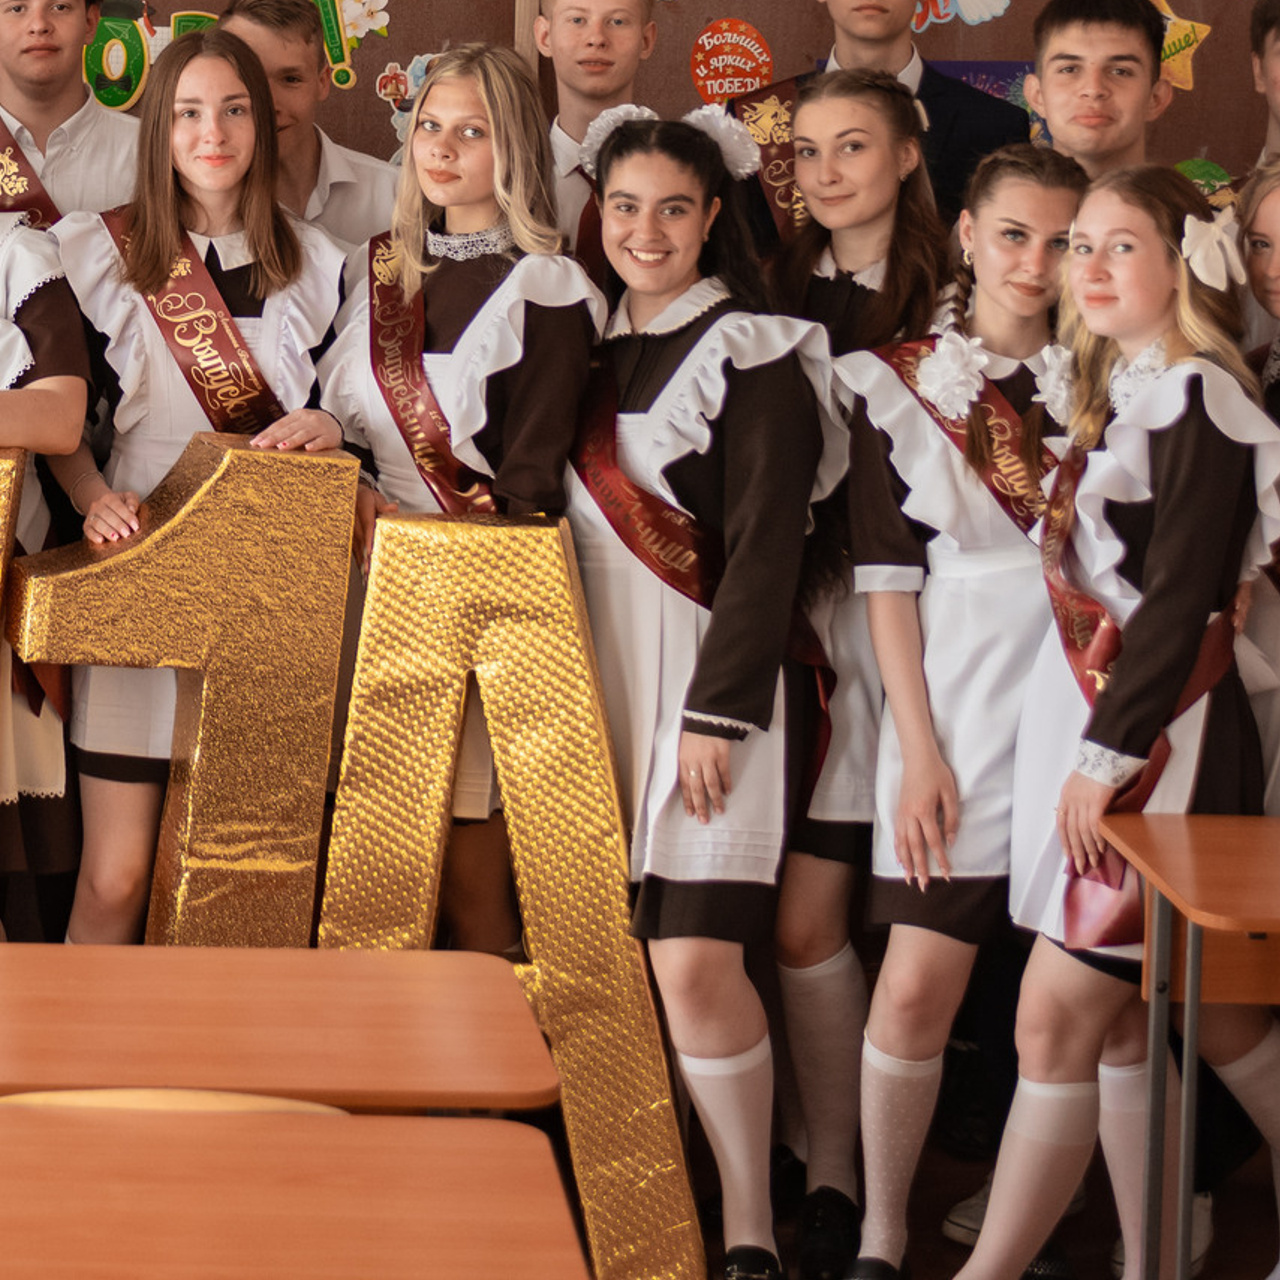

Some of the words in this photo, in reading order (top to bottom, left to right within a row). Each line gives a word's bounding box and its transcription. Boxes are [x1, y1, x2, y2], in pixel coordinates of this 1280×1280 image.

[698, 31, 771, 64] Больших
[696, 64, 708, 77] и
[709, 55, 757, 72] ярких
